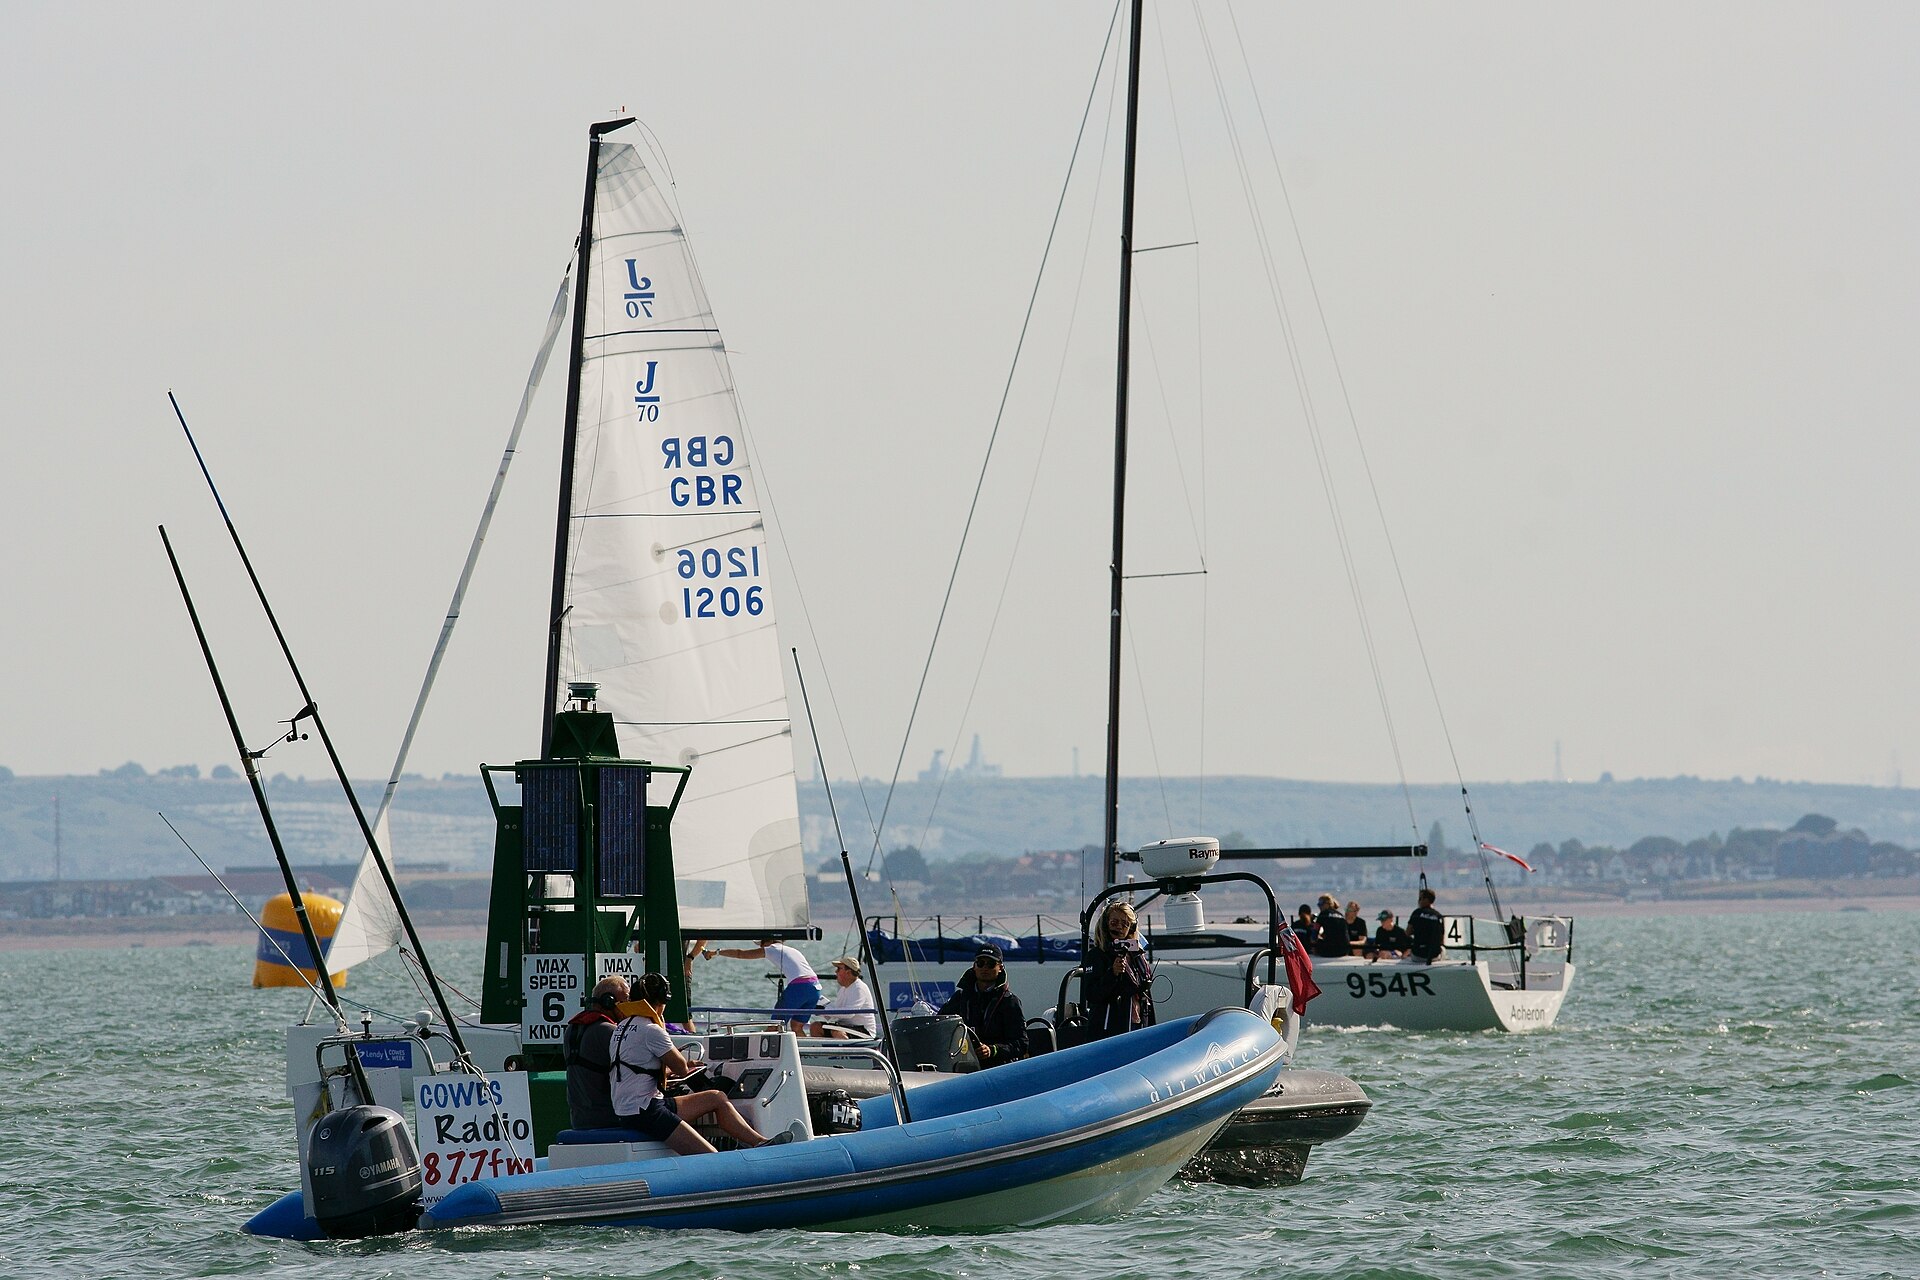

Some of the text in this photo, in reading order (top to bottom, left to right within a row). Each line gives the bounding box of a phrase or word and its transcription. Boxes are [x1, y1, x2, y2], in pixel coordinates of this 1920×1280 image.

[636, 361, 659, 394] J
[637, 404, 659, 423] 70
[670, 474, 743, 507] GBR
[683, 585, 764, 618] 1206
[1447, 919, 1462, 943] 4
[536, 958, 571, 974] MAX
[604, 958, 633, 973] MAX
[529, 975, 578, 990] SPEED
[1346, 972, 1436, 999] 954R
[542, 991, 566, 1023] 6
[1510, 1004, 1545, 1021] Acheron
[365, 1050, 384, 1060] Lendy
[388, 1048, 406, 1056] COWES
[1149, 1043, 1261, 1104] airwaves
[433, 1112, 530, 1145] Radio
[314, 1165, 336, 1177] 115
[369, 1157, 401, 1176] YAMAHA
[423, 1147, 534, 1186] 87.7fm
